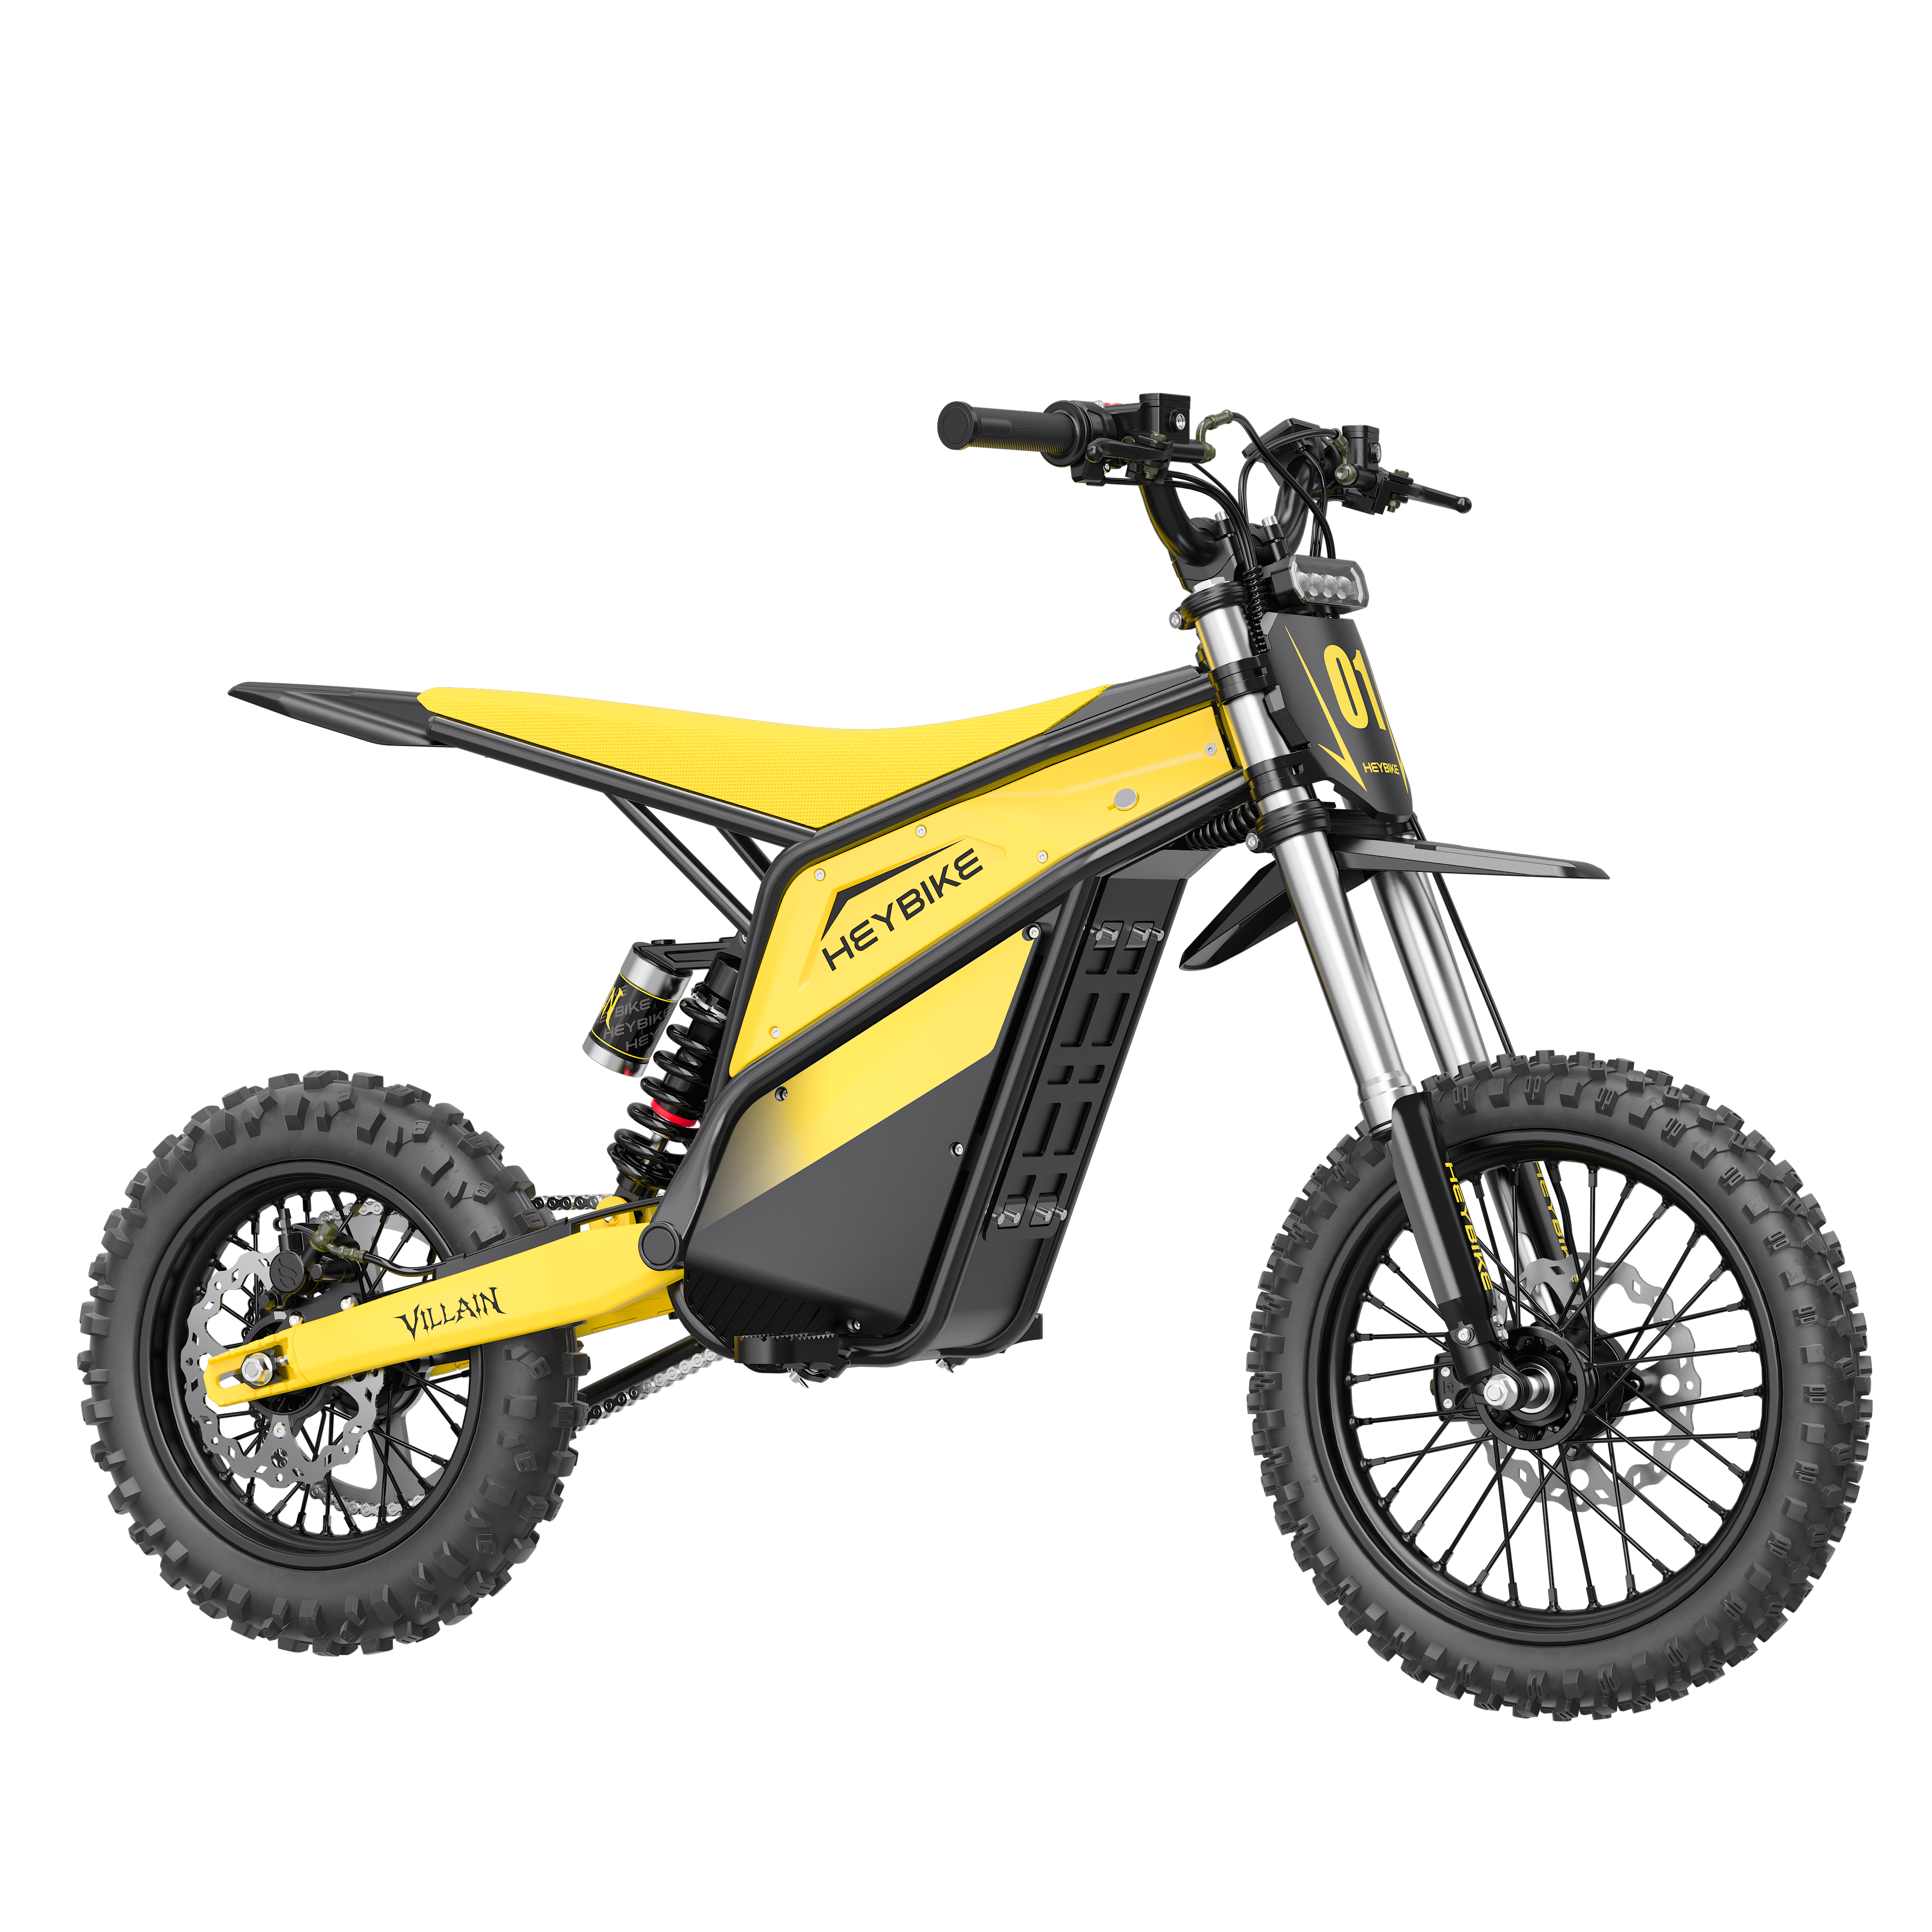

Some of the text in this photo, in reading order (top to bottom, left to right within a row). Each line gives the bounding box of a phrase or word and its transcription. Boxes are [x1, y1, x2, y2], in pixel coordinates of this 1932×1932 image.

[1324, 645, 1386, 731] 01
[1362, 762, 1400, 775] HEYBIKE
[822, 848, 984, 972] HEYBIKE
[1444, 1162, 1493, 1291] HEYBIKE
[392, 1287, 507, 1342] VILLAIN
